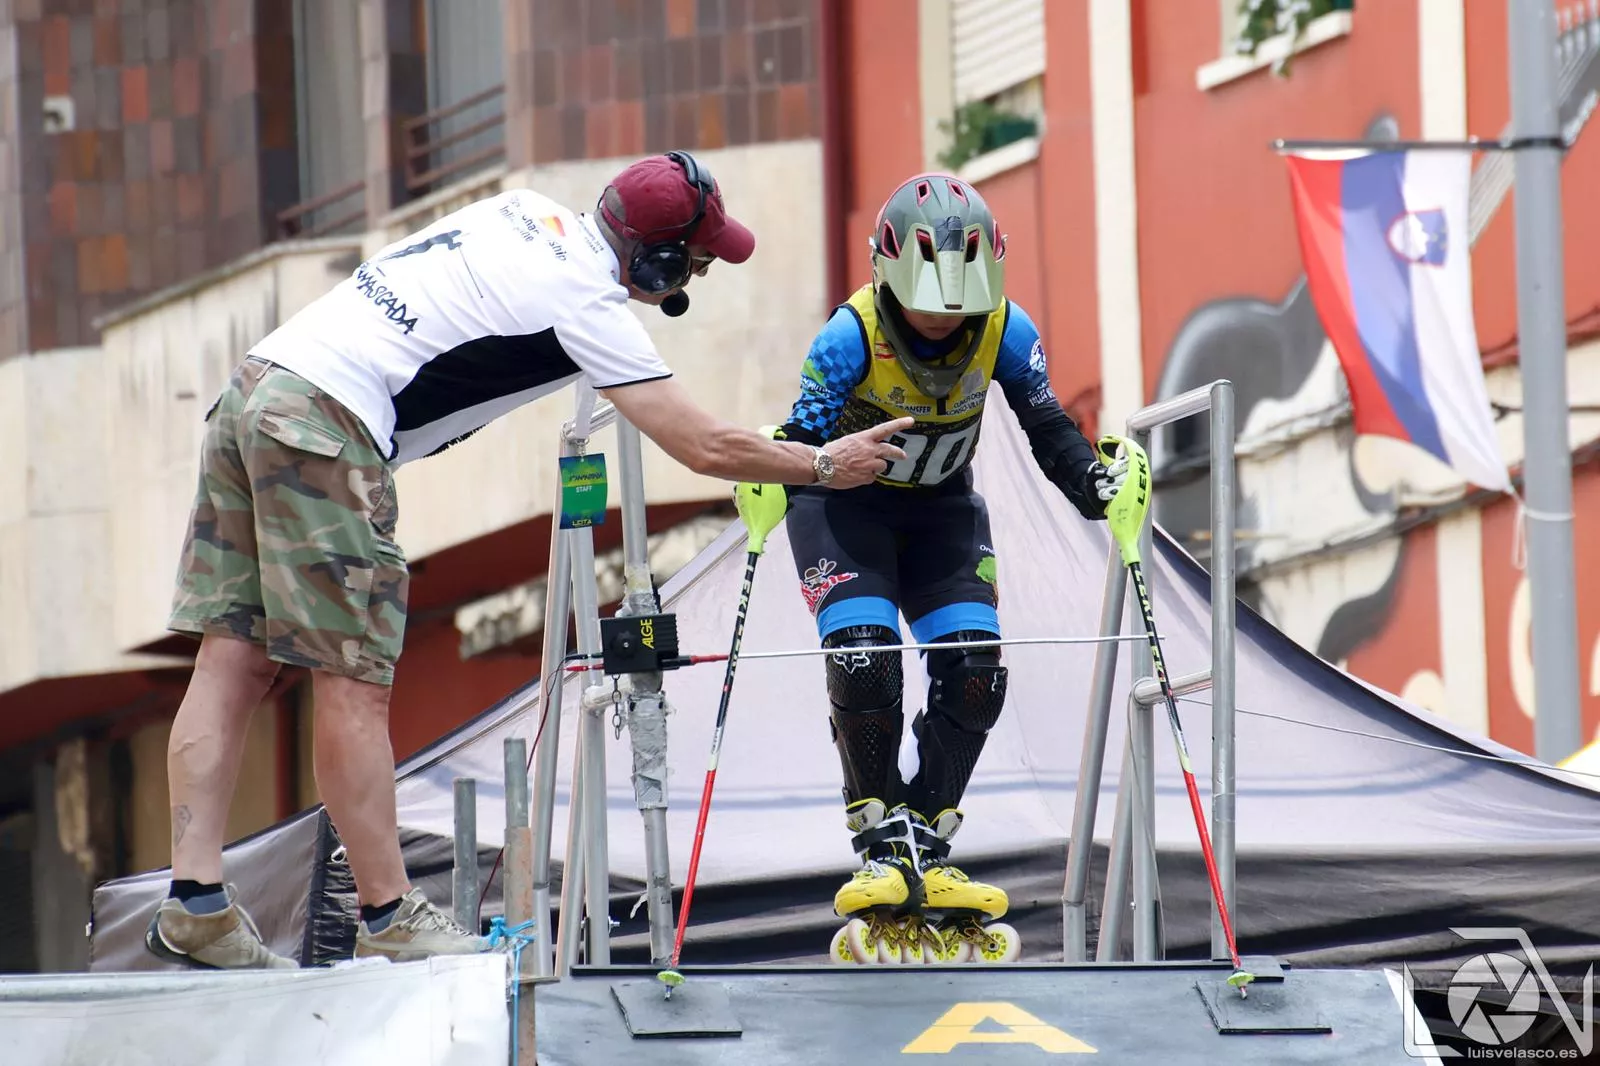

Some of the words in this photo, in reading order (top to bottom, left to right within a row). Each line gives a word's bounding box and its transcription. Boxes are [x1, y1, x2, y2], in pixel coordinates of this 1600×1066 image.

[1135, 452, 1147, 505] LEKI
[640, 619, 655, 649] ALGE
[900, 1001, 1099, 1054] A
